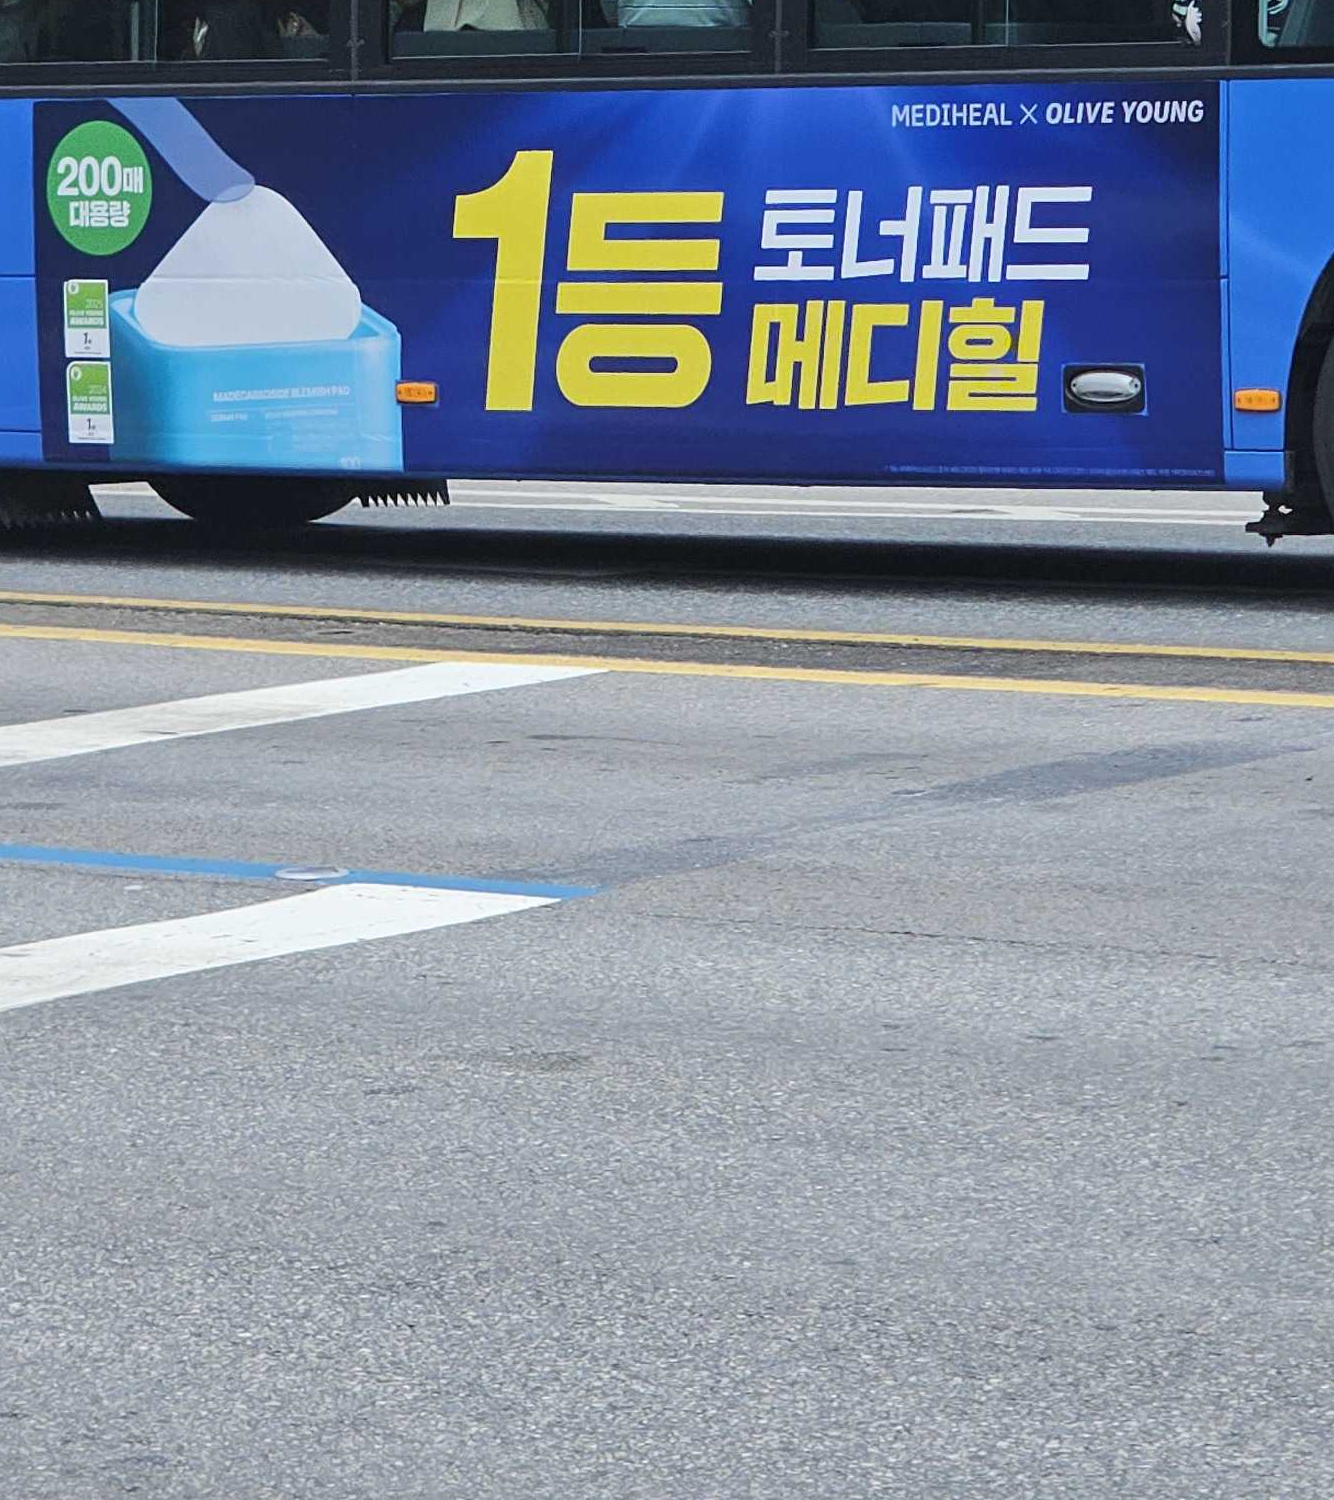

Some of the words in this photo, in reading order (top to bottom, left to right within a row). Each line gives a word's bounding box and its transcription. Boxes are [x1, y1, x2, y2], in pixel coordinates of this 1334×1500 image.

[890, 102, 1013, 127] MEDIHEAL
[1044, 101, 1115, 125] OLIVE
[1121, 99, 1204, 123] YOUNG
[56, 155, 144, 197] 200매
[69, 200, 131, 228] 대용량
[753, 185, 1093, 283] 토너패드
[452, 150, 724, 412] 1등
[745, 297, 1045, 412] 메디힐
